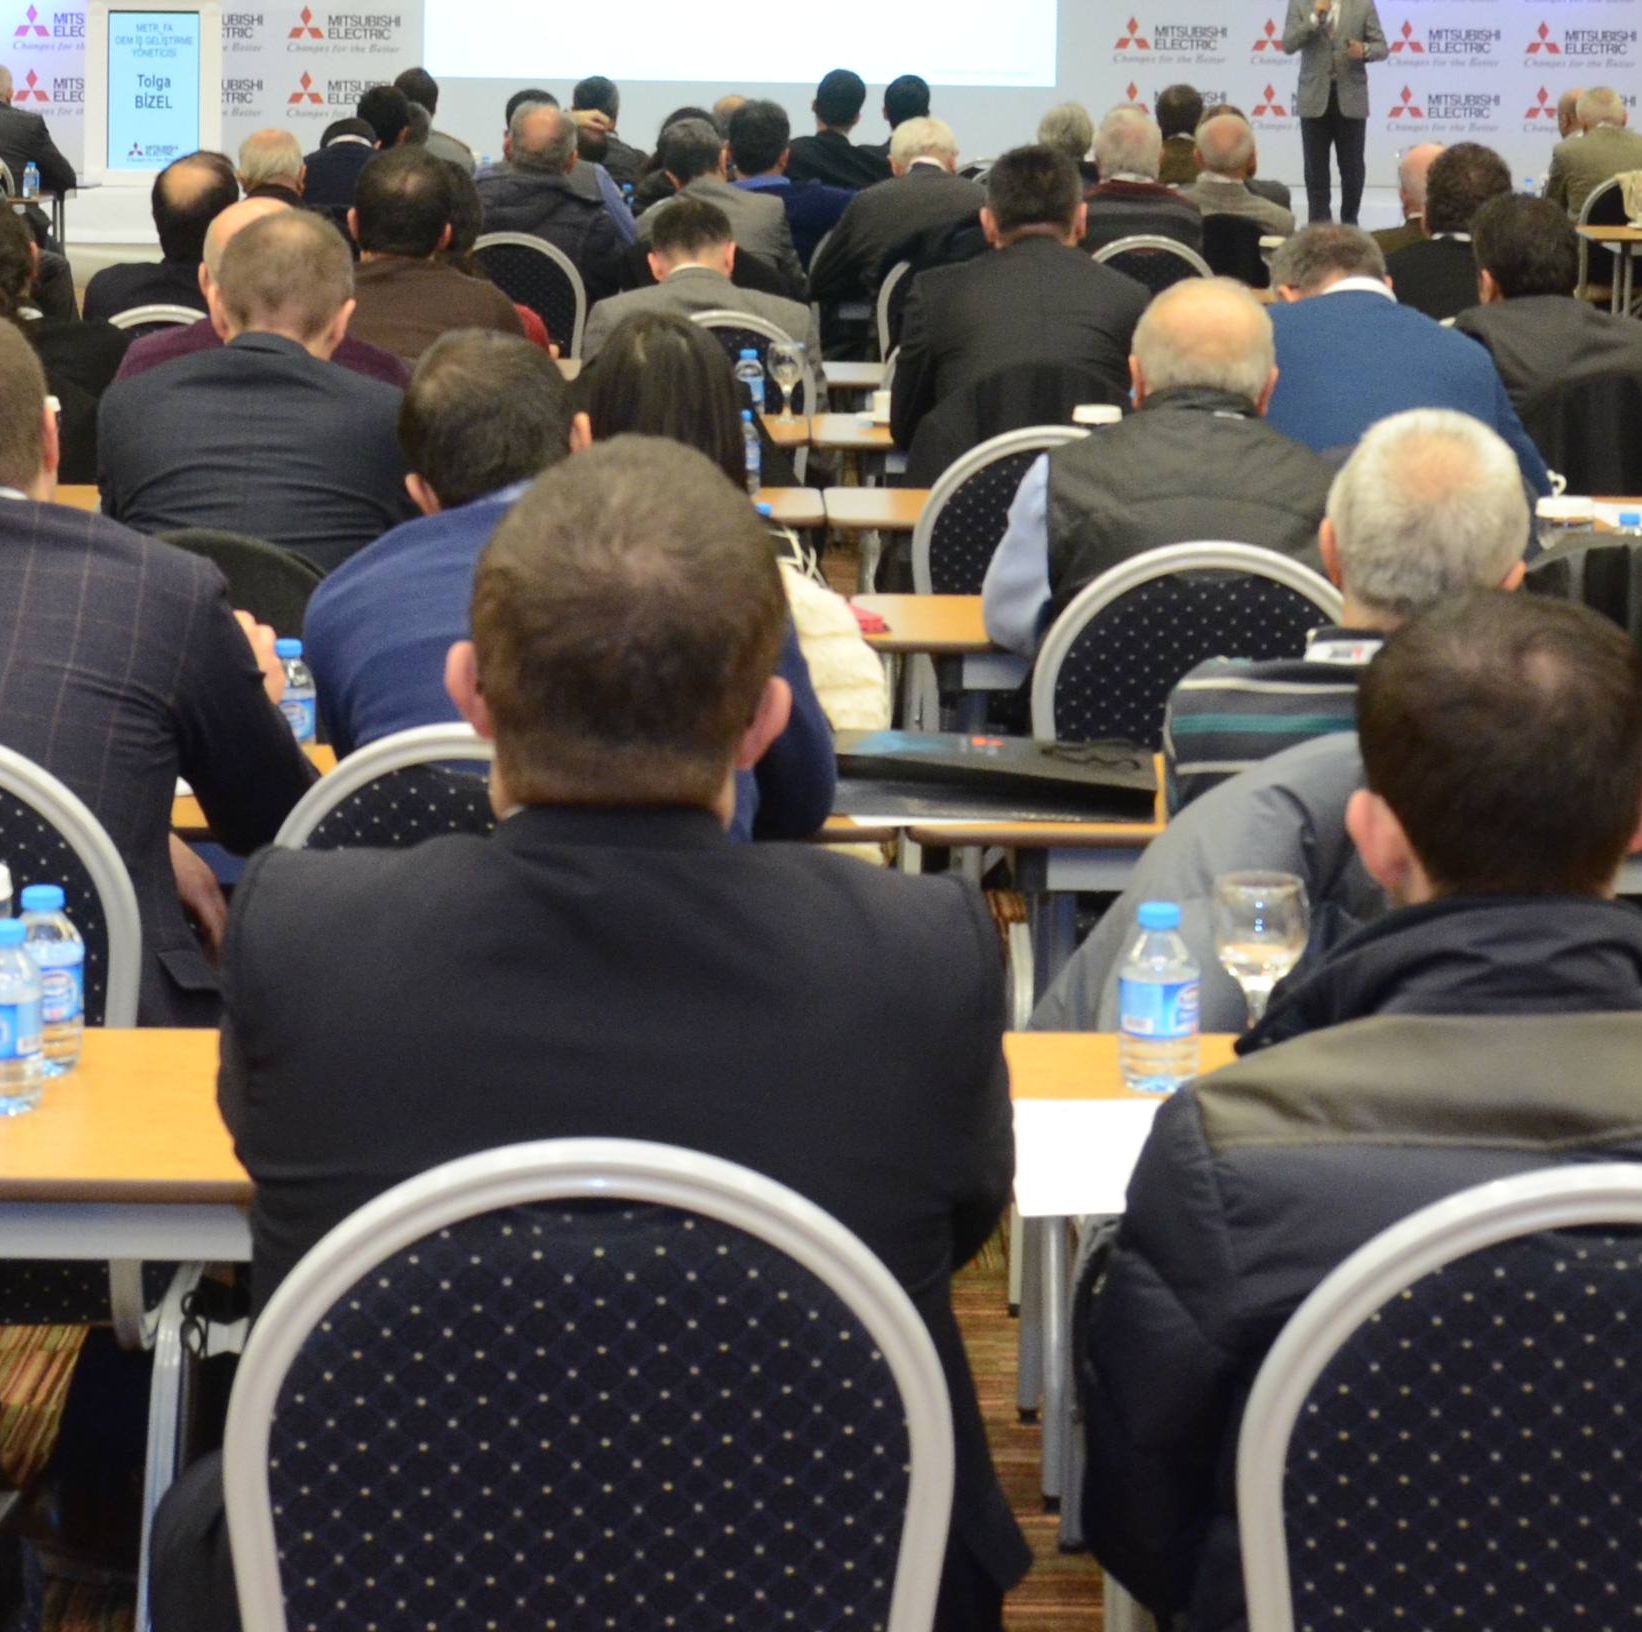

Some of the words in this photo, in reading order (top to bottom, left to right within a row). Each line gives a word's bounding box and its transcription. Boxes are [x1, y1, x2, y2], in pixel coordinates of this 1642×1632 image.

[328, 14, 401, 28] MITSUBISHI
[328, 28, 392, 41] ELECTRIC
[1564, 29, 1637, 43] MITSUBISHI
[1564, 43, 1628, 56] ELECTRIC
[137, 74, 172, 91] Tolga
[135, 92, 173, 109] BİZEL
[1427, 93, 1500, 107] MITSUBISHI
[1427, 107, 1491, 120] ELECTRIC
